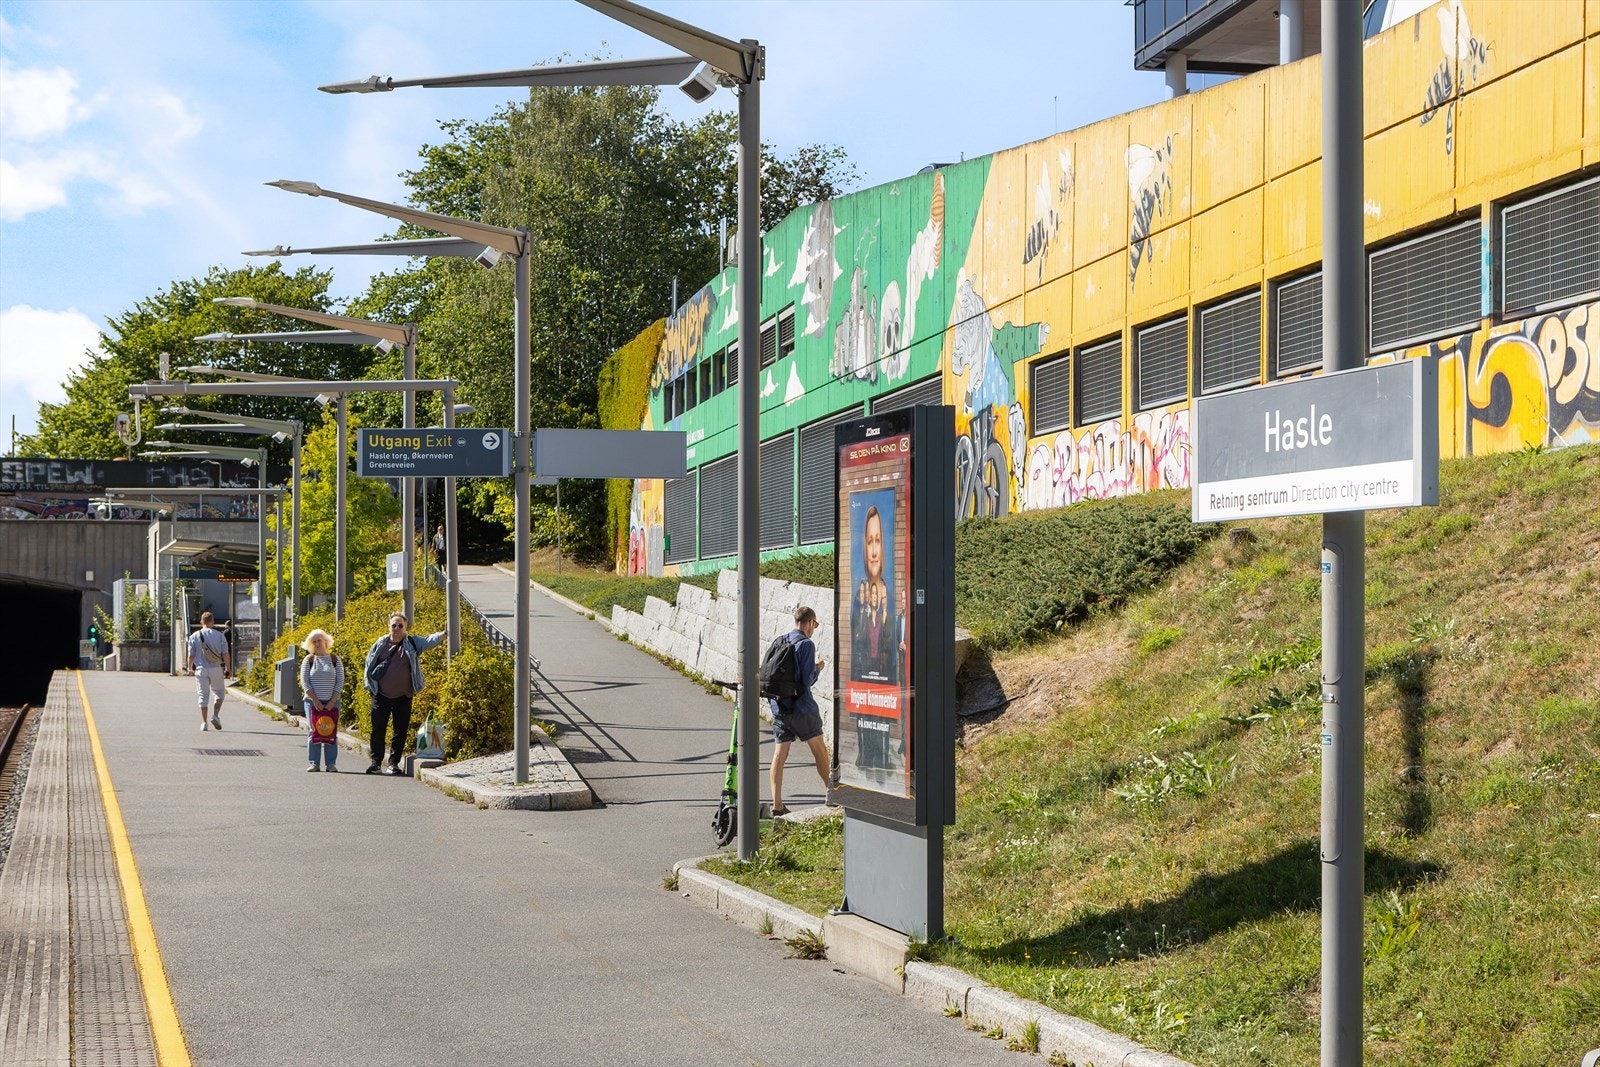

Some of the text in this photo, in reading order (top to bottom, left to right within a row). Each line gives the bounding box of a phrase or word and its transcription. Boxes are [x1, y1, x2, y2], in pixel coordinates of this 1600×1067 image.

[1264, 404, 1333, 453] Hasle
[369, 434, 452, 450] Utgang Exit
[858, 449, 870, 458] DEN
[871, 445, 880, 454] PÅ
[881, 444, 896, 453] KINO
[369, 461, 415, 469] Grenseveien
[1210, 478, 1399, 511] Retning sentrum Direction city centre
[851, 688, 897, 709] Ingen kommentar
